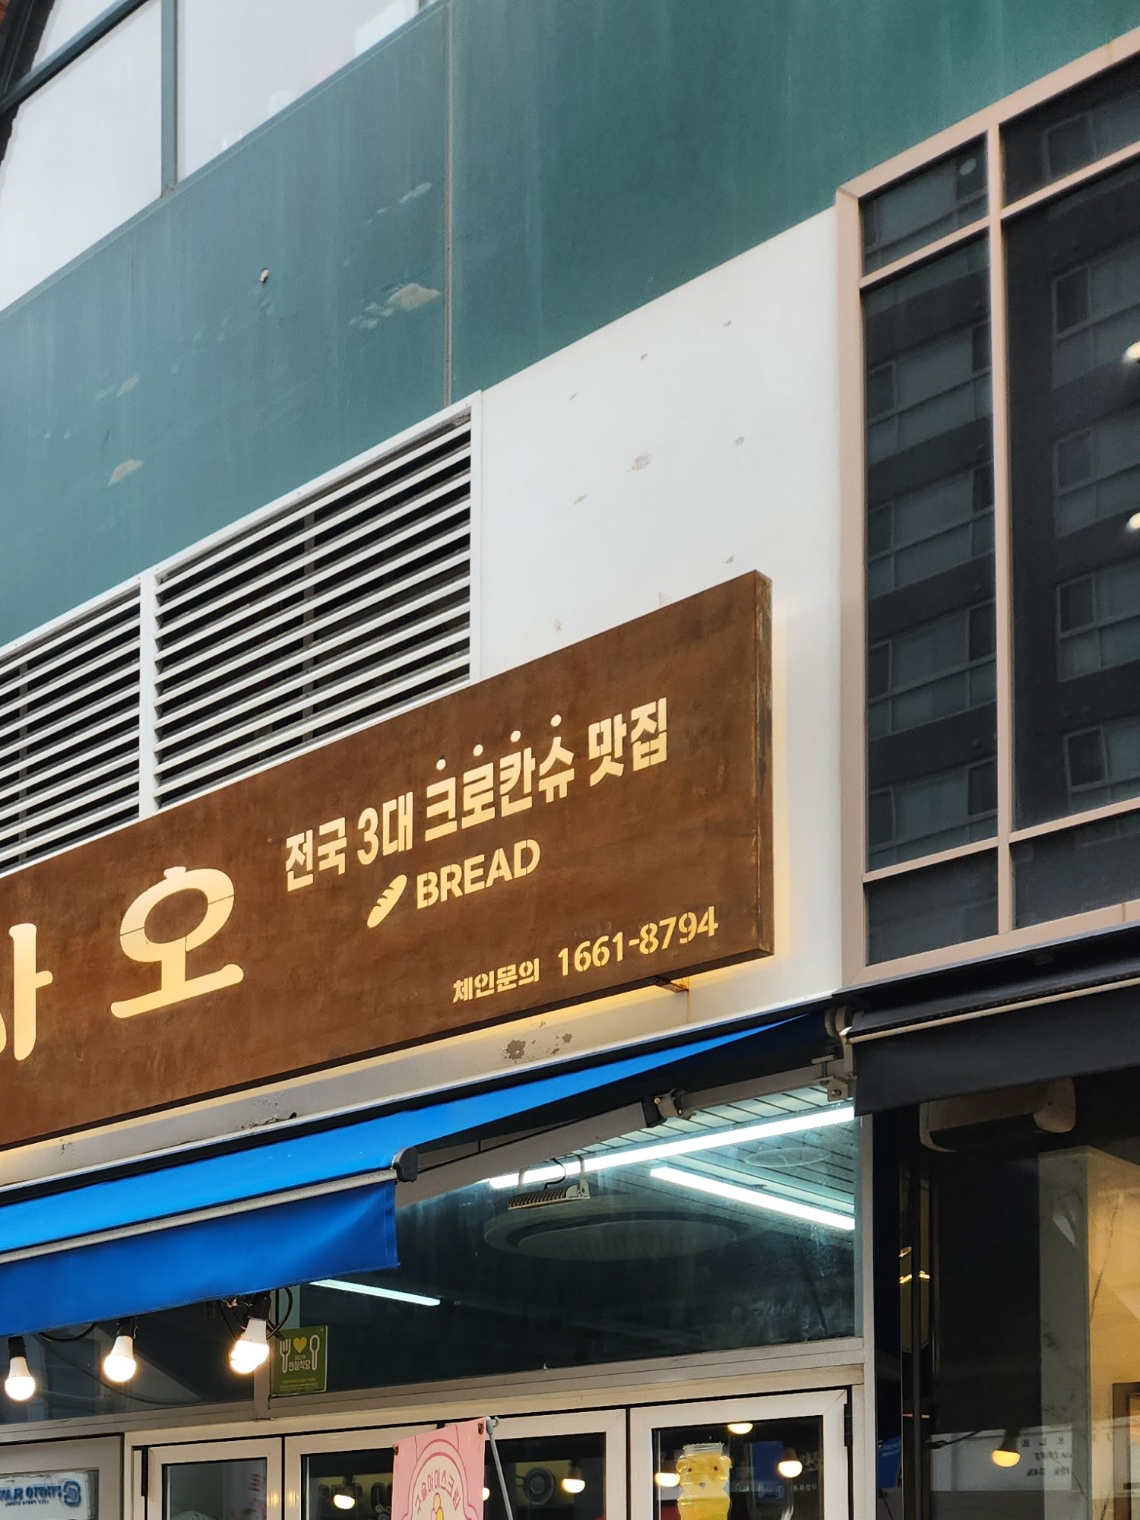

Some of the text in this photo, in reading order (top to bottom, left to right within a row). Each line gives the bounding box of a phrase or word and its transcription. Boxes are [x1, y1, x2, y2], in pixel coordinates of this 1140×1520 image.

[285, 697, 668, 893] 전국 3대 크로칸슈 맛집
[416, 838, 541, 910] BREAD
[452, 905, 719, 1003] 체인문의 1661-8794
